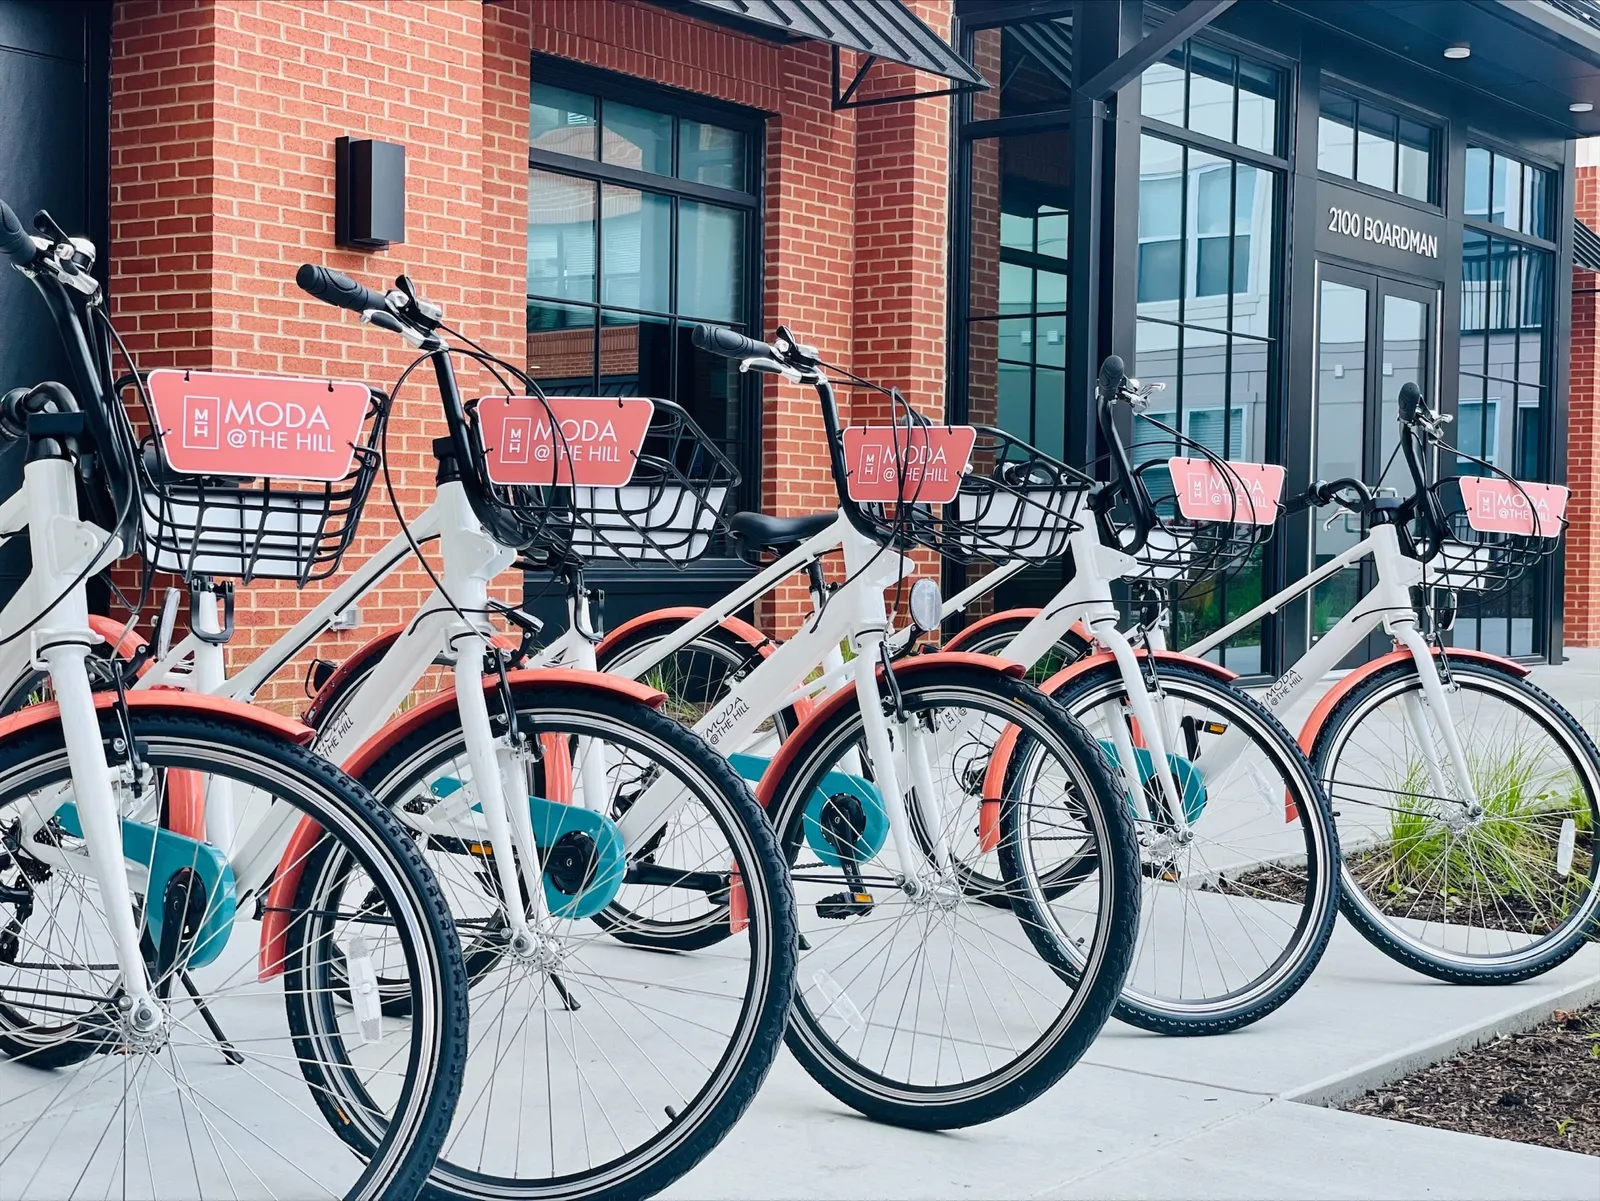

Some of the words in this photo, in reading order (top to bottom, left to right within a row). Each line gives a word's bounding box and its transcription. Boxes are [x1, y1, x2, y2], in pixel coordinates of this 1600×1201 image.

[1328, 207, 1360, 238] 2100
[1363, 216, 1437, 258] BOARDMAN
[224, 398, 330, 430] MODA
[227, 428, 288, 449] @THE
[296, 433, 335, 452] HILL
[533, 418, 618, 442] MODA
[589, 445, 620, 462] HILL
[924, 467, 949, 482] HILL
[1266, 669, 1297, 700] MODA
[1289, 674, 1304, 688] HILL
[338, 717, 354, 739] HILL
[706, 697, 743, 738] MODA
[710, 719, 734, 745] @THE
[732, 703, 751, 721] HILL
